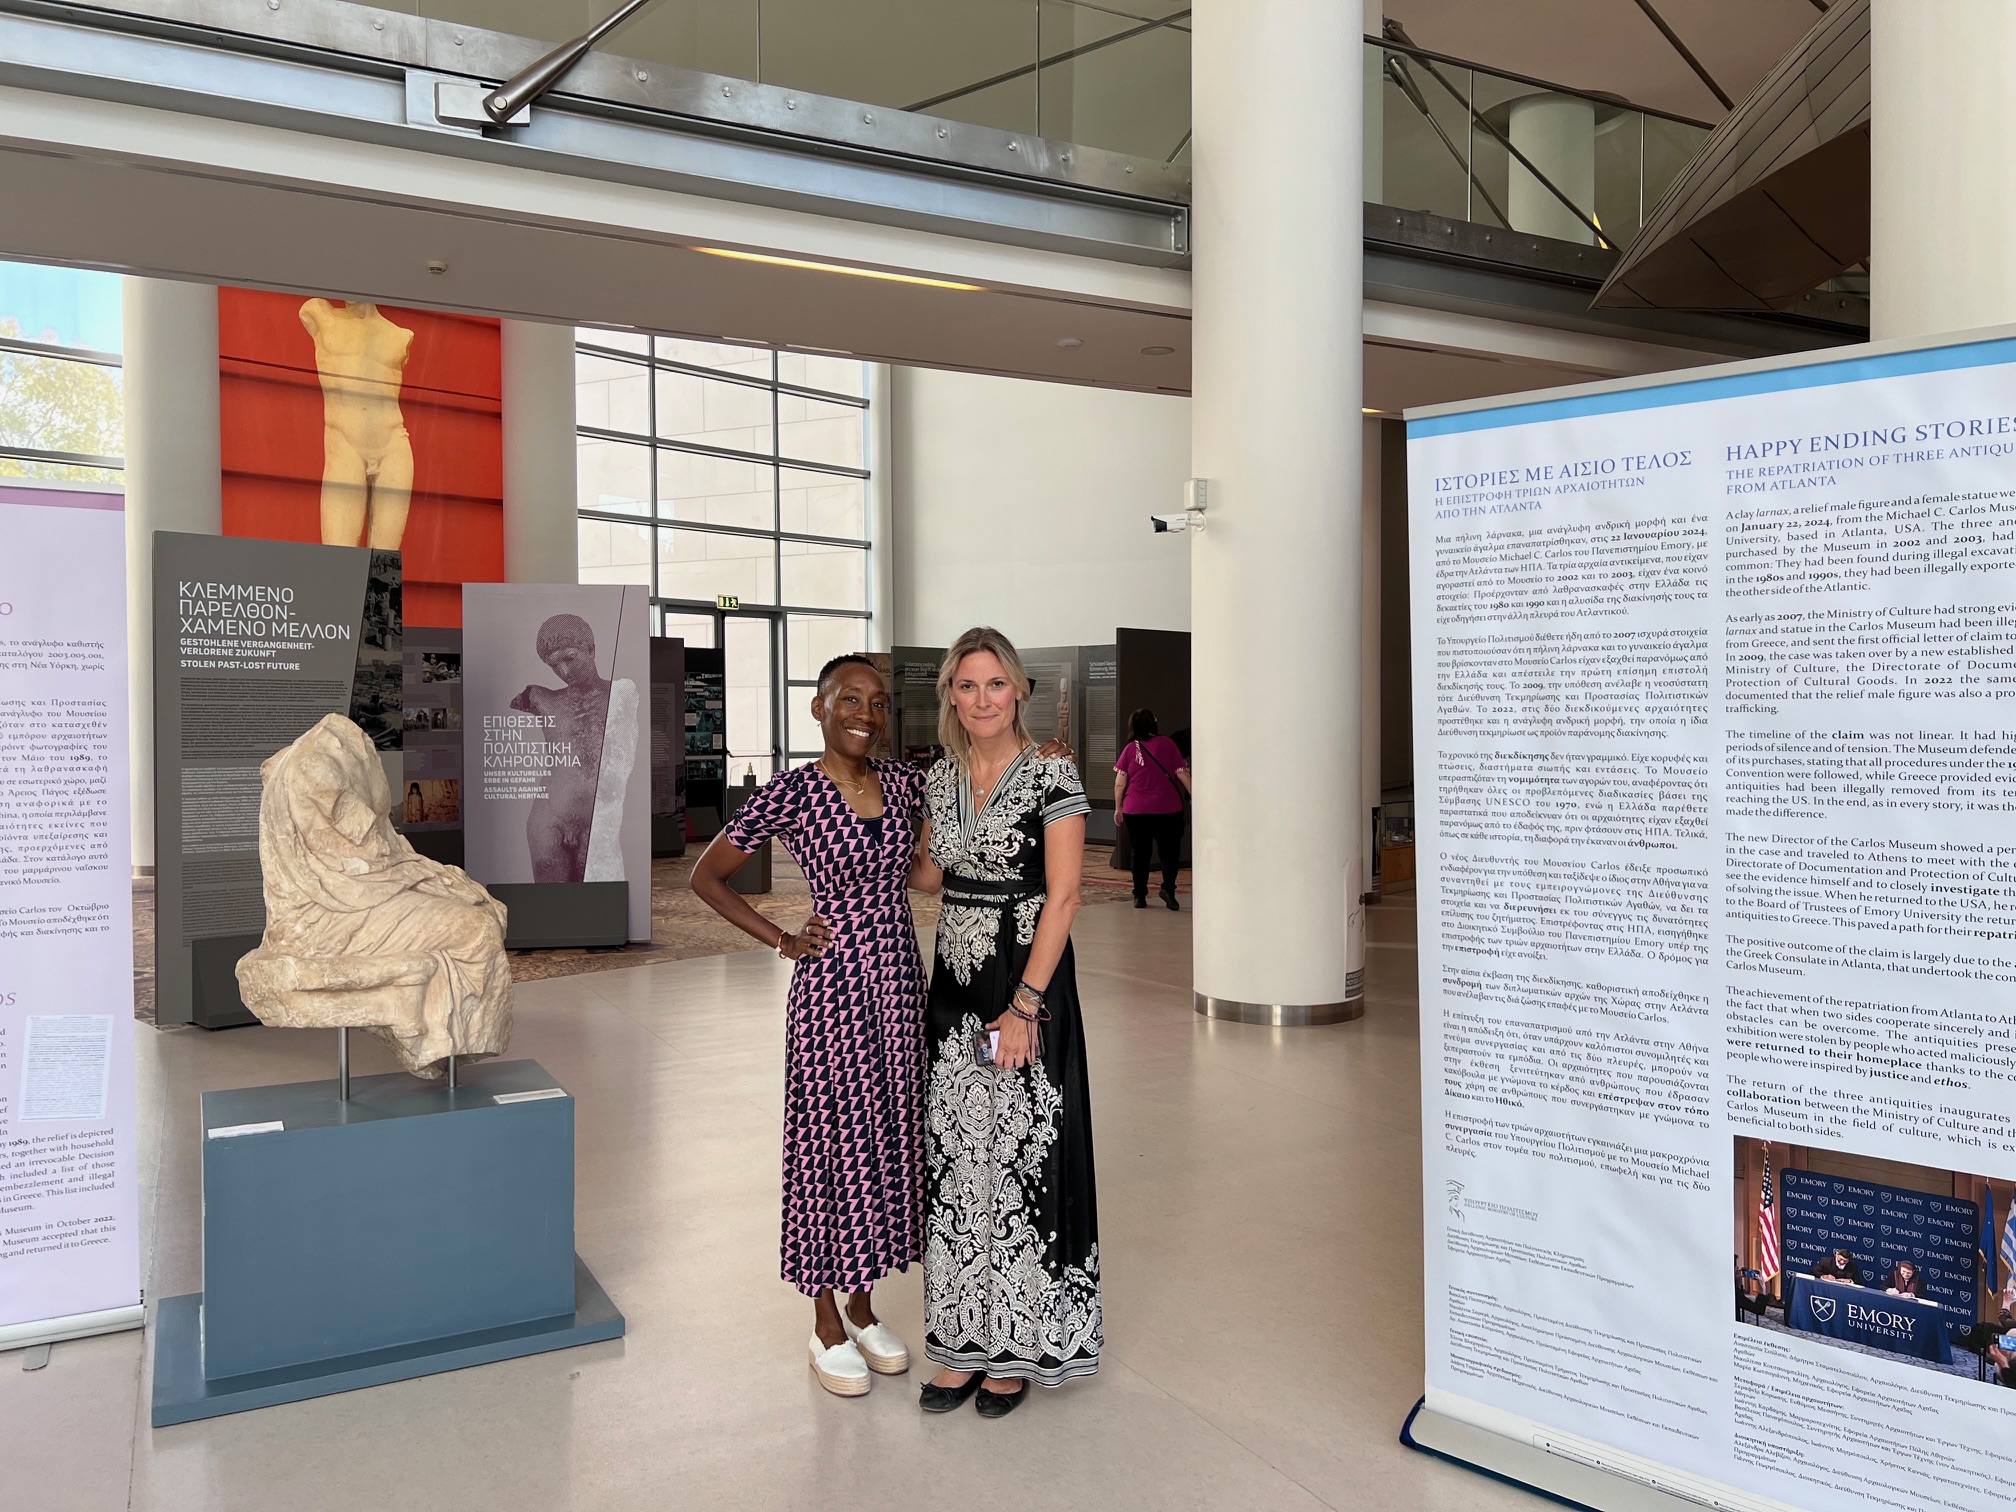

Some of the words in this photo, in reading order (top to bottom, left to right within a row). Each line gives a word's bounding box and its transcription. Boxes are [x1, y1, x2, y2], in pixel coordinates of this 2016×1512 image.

[1727, 438, 1802, 461] HAPPY
[1810, 426, 1906, 452] ENDING
[1726, 468, 1753, 479] THE
[1758, 457, 1863, 476] REPATRIATION
[1869, 454, 1889, 466] OF
[1892, 449, 1944, 463] THREE
[1436, 469, 1519, 491] ΙΣΤΟΡΙΕΣ
[1526, 465, 1553, 481] ΜΕ
[1558, 458, 1615, 478] ΑΙΣΙΟ
[1621, 450, 1691, 471] ΤΕΛΟΣ
[1726, 482, 1765, 494] FROM
[1769, 475, 1836, 490] ATLANTA
[1435, 497, 1442, 506] Η
[1446, 490, 1512, 505] ΕΠΙΣΤΡΟΦΗ
[1514, 486, 1550, 498] ΤΡΙΩΝ
[1554, 476, 1644, 494] ΑΡΧΑΙΟΤΗΤΩΝ
[1435, 508, 1460, 519] ΑΠΟ
[1462, 506, 1485, 516] ΤΗΝ
[1489, 501, 1541, 514] ΑΤΛΑΝΤΑ
[1726, 534, 1780, 545] University,
[1787, 530, 1817, 541] based
[1825, 530, 1835, 538] in
[1841, 527, 1886, 537] Atlanta,
[1894, 523, 1924, 533] USA.
[1931, 520, 1954, 530] The
[179, 581, 293, 603] ΚΛΕΜΜΕΝΟ
[180, 599, 295, 620] ΠΑΡΕΛΘΟΝ-
[180, 617, 265, 636] ΧΑΜΕΝΟ
[272, 621, 349, 639] ΜΕΛΛΟΝ
[21, 639, 64, 648] ανάγλυφο
[66, 640, 104, 649] καθιστής
[180, 637, 239, 647] GESTOHLENE
[240, 640, 314, 649] VERGANGENHEIT-
[180, 646, 233, 656] VERLORENE
[235, 648, 276, 657] ZUKUNFT
[49, 661, 78, 671] Υόρκη,
[81, 663, 104, 671] χωρίς
[180, 659, 215, 668] STOLEN
[218, 660, 265, 669] PAST-LOST
[266, 662, 300, 670] FUTURE
[51, 698, 106, 707] Προστασίας
[1437, 705, 1471, 715] Αγαθών.
[1521, 706, 1540, 714] στις
[1544, 704, 1560, 712] δύο
[1564, 703, 1639, 714] διεκδικούμενες
[1644, 703, 1708, 714] αρχαιότητες
[484, 715, 555, 727] ΕΠΙΘΕΣΕΙΣ
[484, 728, 522, 741] ΣΤΗΝ
[1728, 730, 1745, 738] The
[1749, 730, 1791, 738] timeline
[1794, 730, 1806, 738] of
[1810, 730, 1827, 739] the
[1831, 730, 1864, 739] claim
[1919, 730, 1954, 739] linear.
[1960, 730, 1967, 739] It
[1974, 730, 1996, 740] had
[484, 741, 571, 754] ΠΟΛΙΤΙΣΤΙΚΗ
[484, 755, 581, 767] ΚΛΗΡΟΝΟΜΙΑ
[8, 789, 37, 797] Άρειος
[42, 788, 68, 797] Πάγος
[73, 787, 106, 795] εξέδωσε
[1439, 795, 1481, 806] Σύμβασης
[1486, 797, 1530, 806] UNESCO
[1585, 801, 1602, 809] ενώ
[1619, 801, 1656, 811] Ελλάδα
[1662, 803, 1708, 814] παρέθετε
[18, 906, 46, 914] Carlos
[67, 902, 109, 911] Οκτώβριο
[1726, 960, 1756, 971] Carlos
[1758, 963, 1805, 975] Museum.
[1726, 1038, 1751, 1047] were
[1755, 1042, 1804, 1054] returned
[1824, 1048, 1852, 1059] their
[1856, 1052, 1922, 1069] homeplace
[1926, 1061, 1965, 1074] thanks
[1969, 1068, 1980, 1076] to
[1985, 1068, 2003, 1079] the
[1727, 1112, 1775, 1127] beneficial
[1777, 1121, 1787, 1129] to
[1789, 1121, 1813, 1133] both
[1814, 1126, 1843, 1138] sides.
[8, 1138, 30, 1147] 1989,
[47, 1132, 69, 1142] relief
[78, 1127, 113, 1139] depicted
[1445, 1144, 1477, 1158] πλευρές.
[10, 1168, 47, 1179] included
[78, 1162, 87, 1170] of
[92, 1161, 114, 1169] those
[1800, 1177, 1827, 1187] EMORY
[1786, 1190, 1812, 1200] EMORY
[1848, 1186, 1875, 1196] EMORY
[1831, 1198, 1857, 1209] EMORY
[1896, 1195, 1923, 1205] EMORY
[1800, 1209, 1827, 1220] EMORY
[1881, 1208, 1908, 1219] EMORY
[1945, 1204, 1973, 1215] EMORY
[5, 1225, 41, 1235] Museum
[56, 1218, 91, 1227] October
[1786, 1223, 1812, 1233] EMORY
[1848, 1218, 1874, 1229] EMORY
[1927, 1217, 1955, 1228] EMORY
[1831, 1231, 1857, 1242] EMORY
[1896, 1227, 1922, 1238] EMORY
[1800, 1242, 1826, 1252] EMORY
[1881, 1241, 1908, 1252] EMORY
[1945, 1237, 1972, 1249] EMORY
[1786, 1255, 1812, 1265] EMORY
[1850, 1251, 1874, 1262] MORY
[1926, 1250, 1954, 1262] EMORY
[1944, 1271, 1972, 1282] EMORY
[1926, 1284, 1953, 1295] EMORY
[1944, 1304, 1971, 1316] EMORY
[1847, 1303, 1915, 1331] EMORY
[1848, 1319, 1913, 1340] UNIVERSITY
